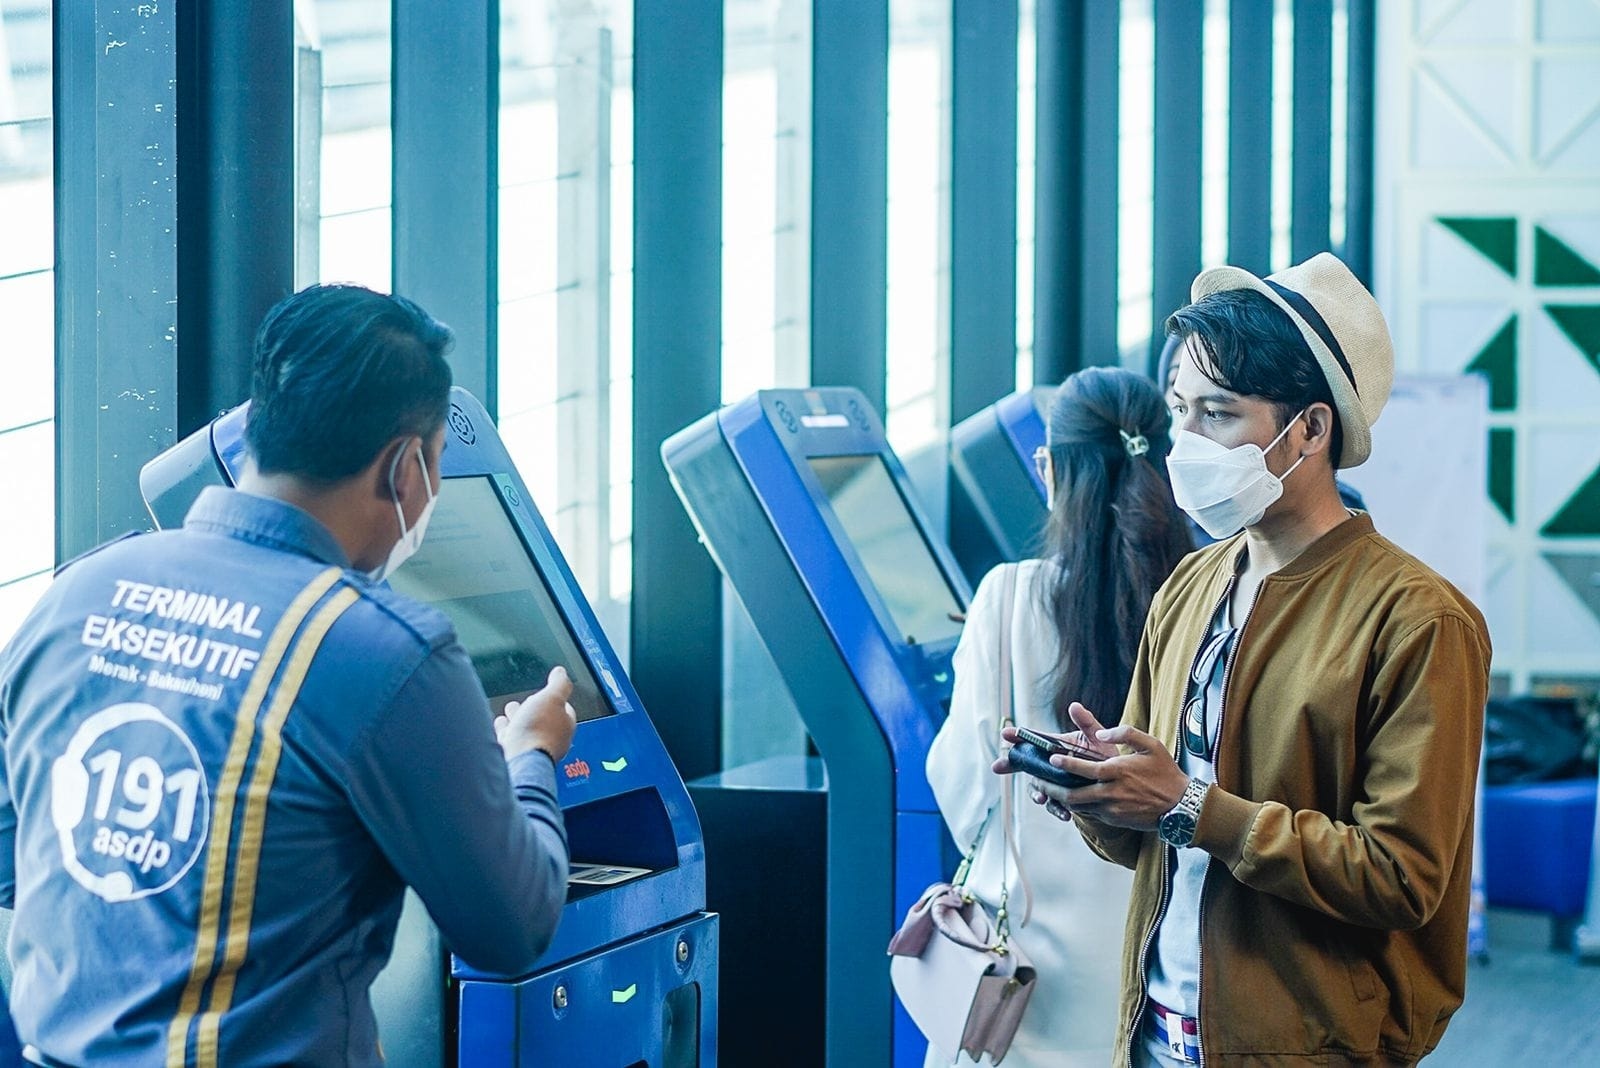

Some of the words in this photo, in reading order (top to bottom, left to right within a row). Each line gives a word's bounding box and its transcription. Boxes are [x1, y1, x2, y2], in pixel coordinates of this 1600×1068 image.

[110, 579, 263, 639] TERMINAL
[81, 614, 260, 680] EKSEKUTIF
[89, 749, 201, 843] 191
[564, 757, 591, 779] asdp
[92, 826, 171, 873] asdp
